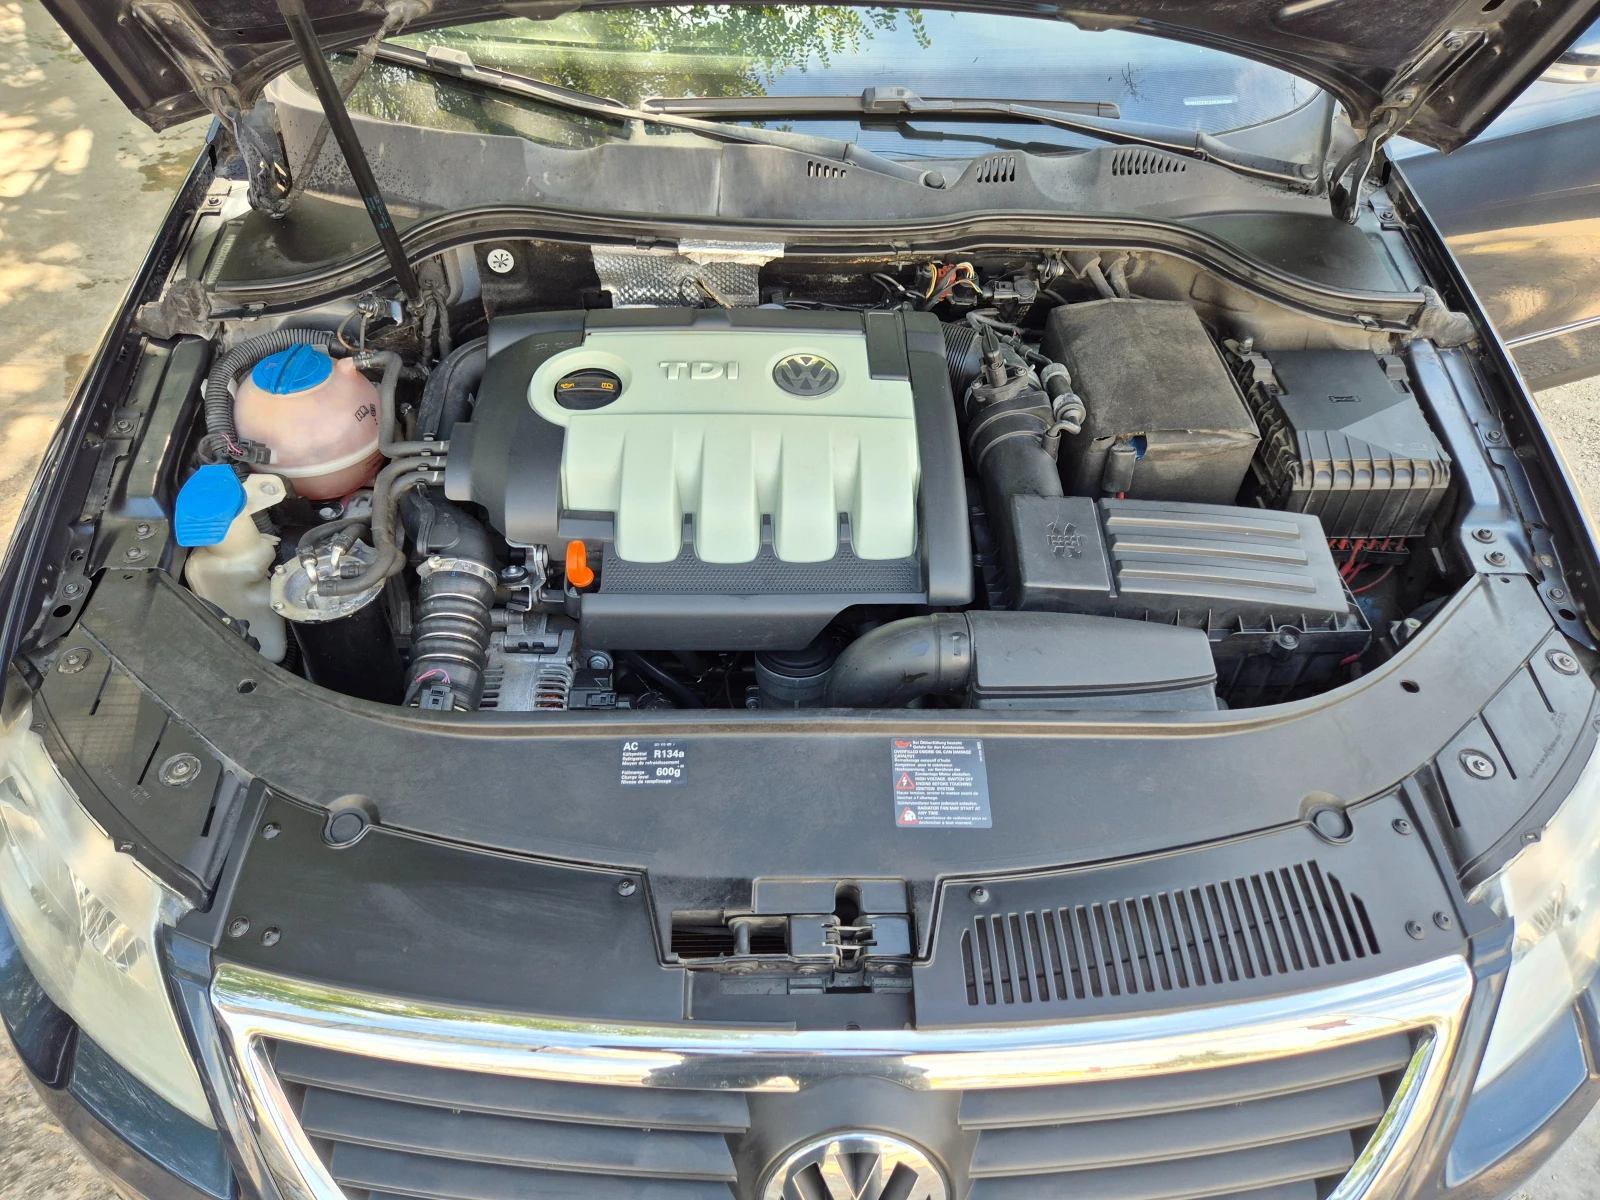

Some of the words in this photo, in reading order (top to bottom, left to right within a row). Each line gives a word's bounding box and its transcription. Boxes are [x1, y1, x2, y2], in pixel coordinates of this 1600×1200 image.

[659, 361, 740, 380] TDI
[623, 742, 638, 750] AC
[654, 750, 684, 758] R134a
[656, 767, 680, 777] 600g
